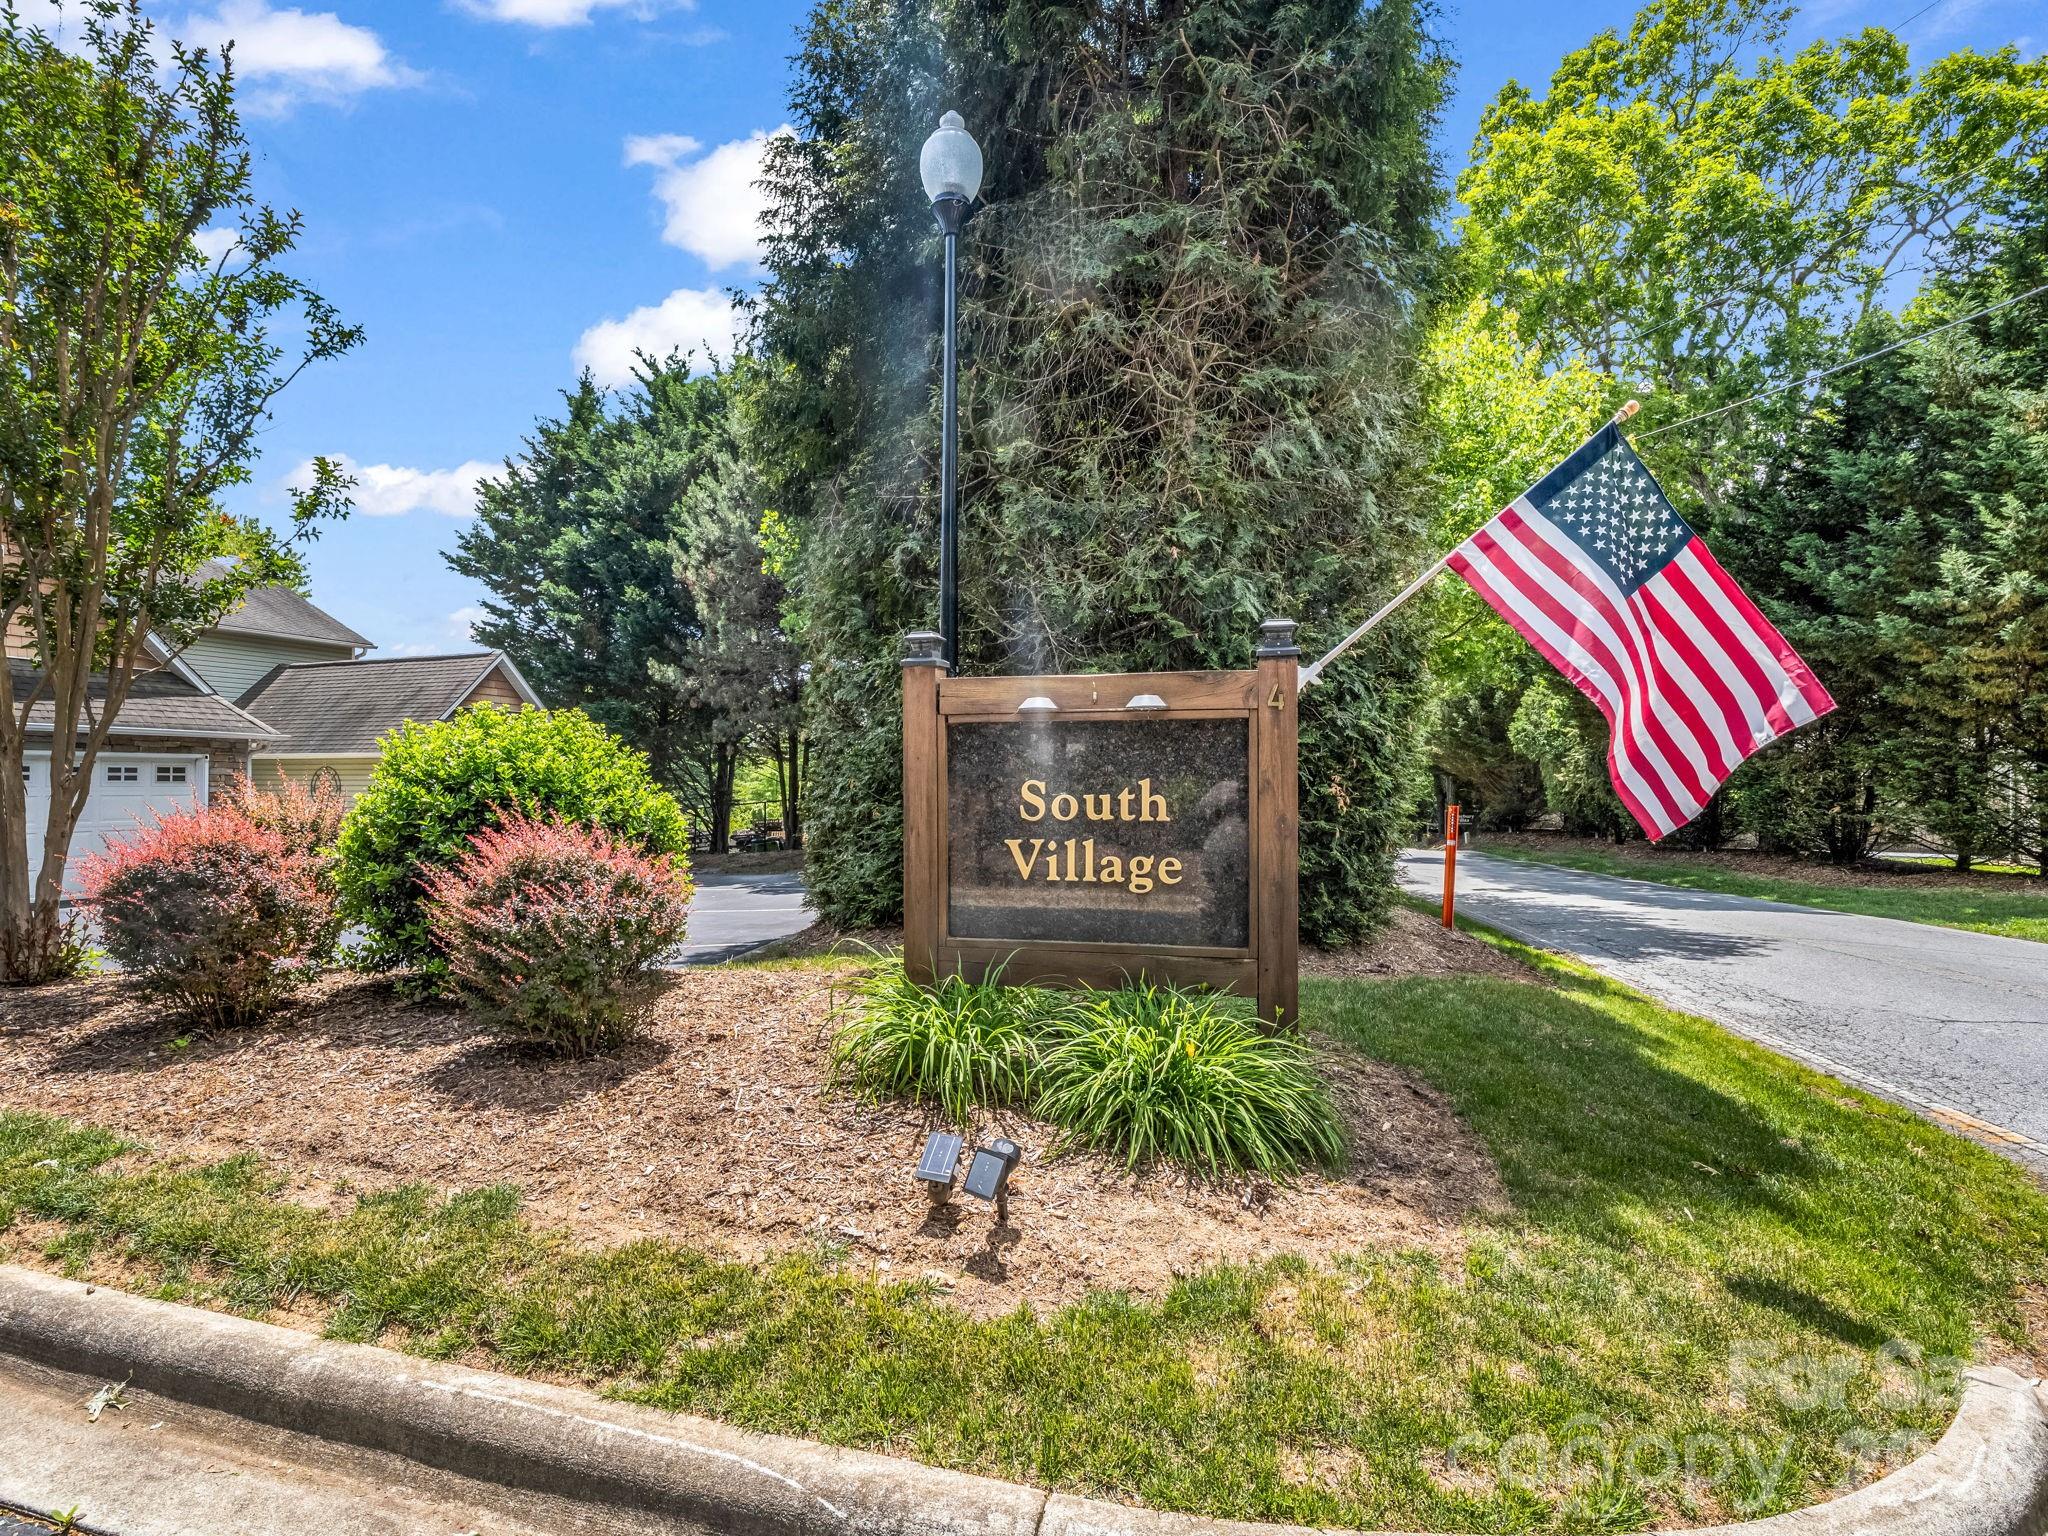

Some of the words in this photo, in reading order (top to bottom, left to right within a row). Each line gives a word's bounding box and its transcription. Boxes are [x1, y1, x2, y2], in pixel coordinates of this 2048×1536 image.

[1267, 682, 1285, 711] 4
[1019, 778, 1171, 822] South
[1004, 838, 1183, 894] Village
